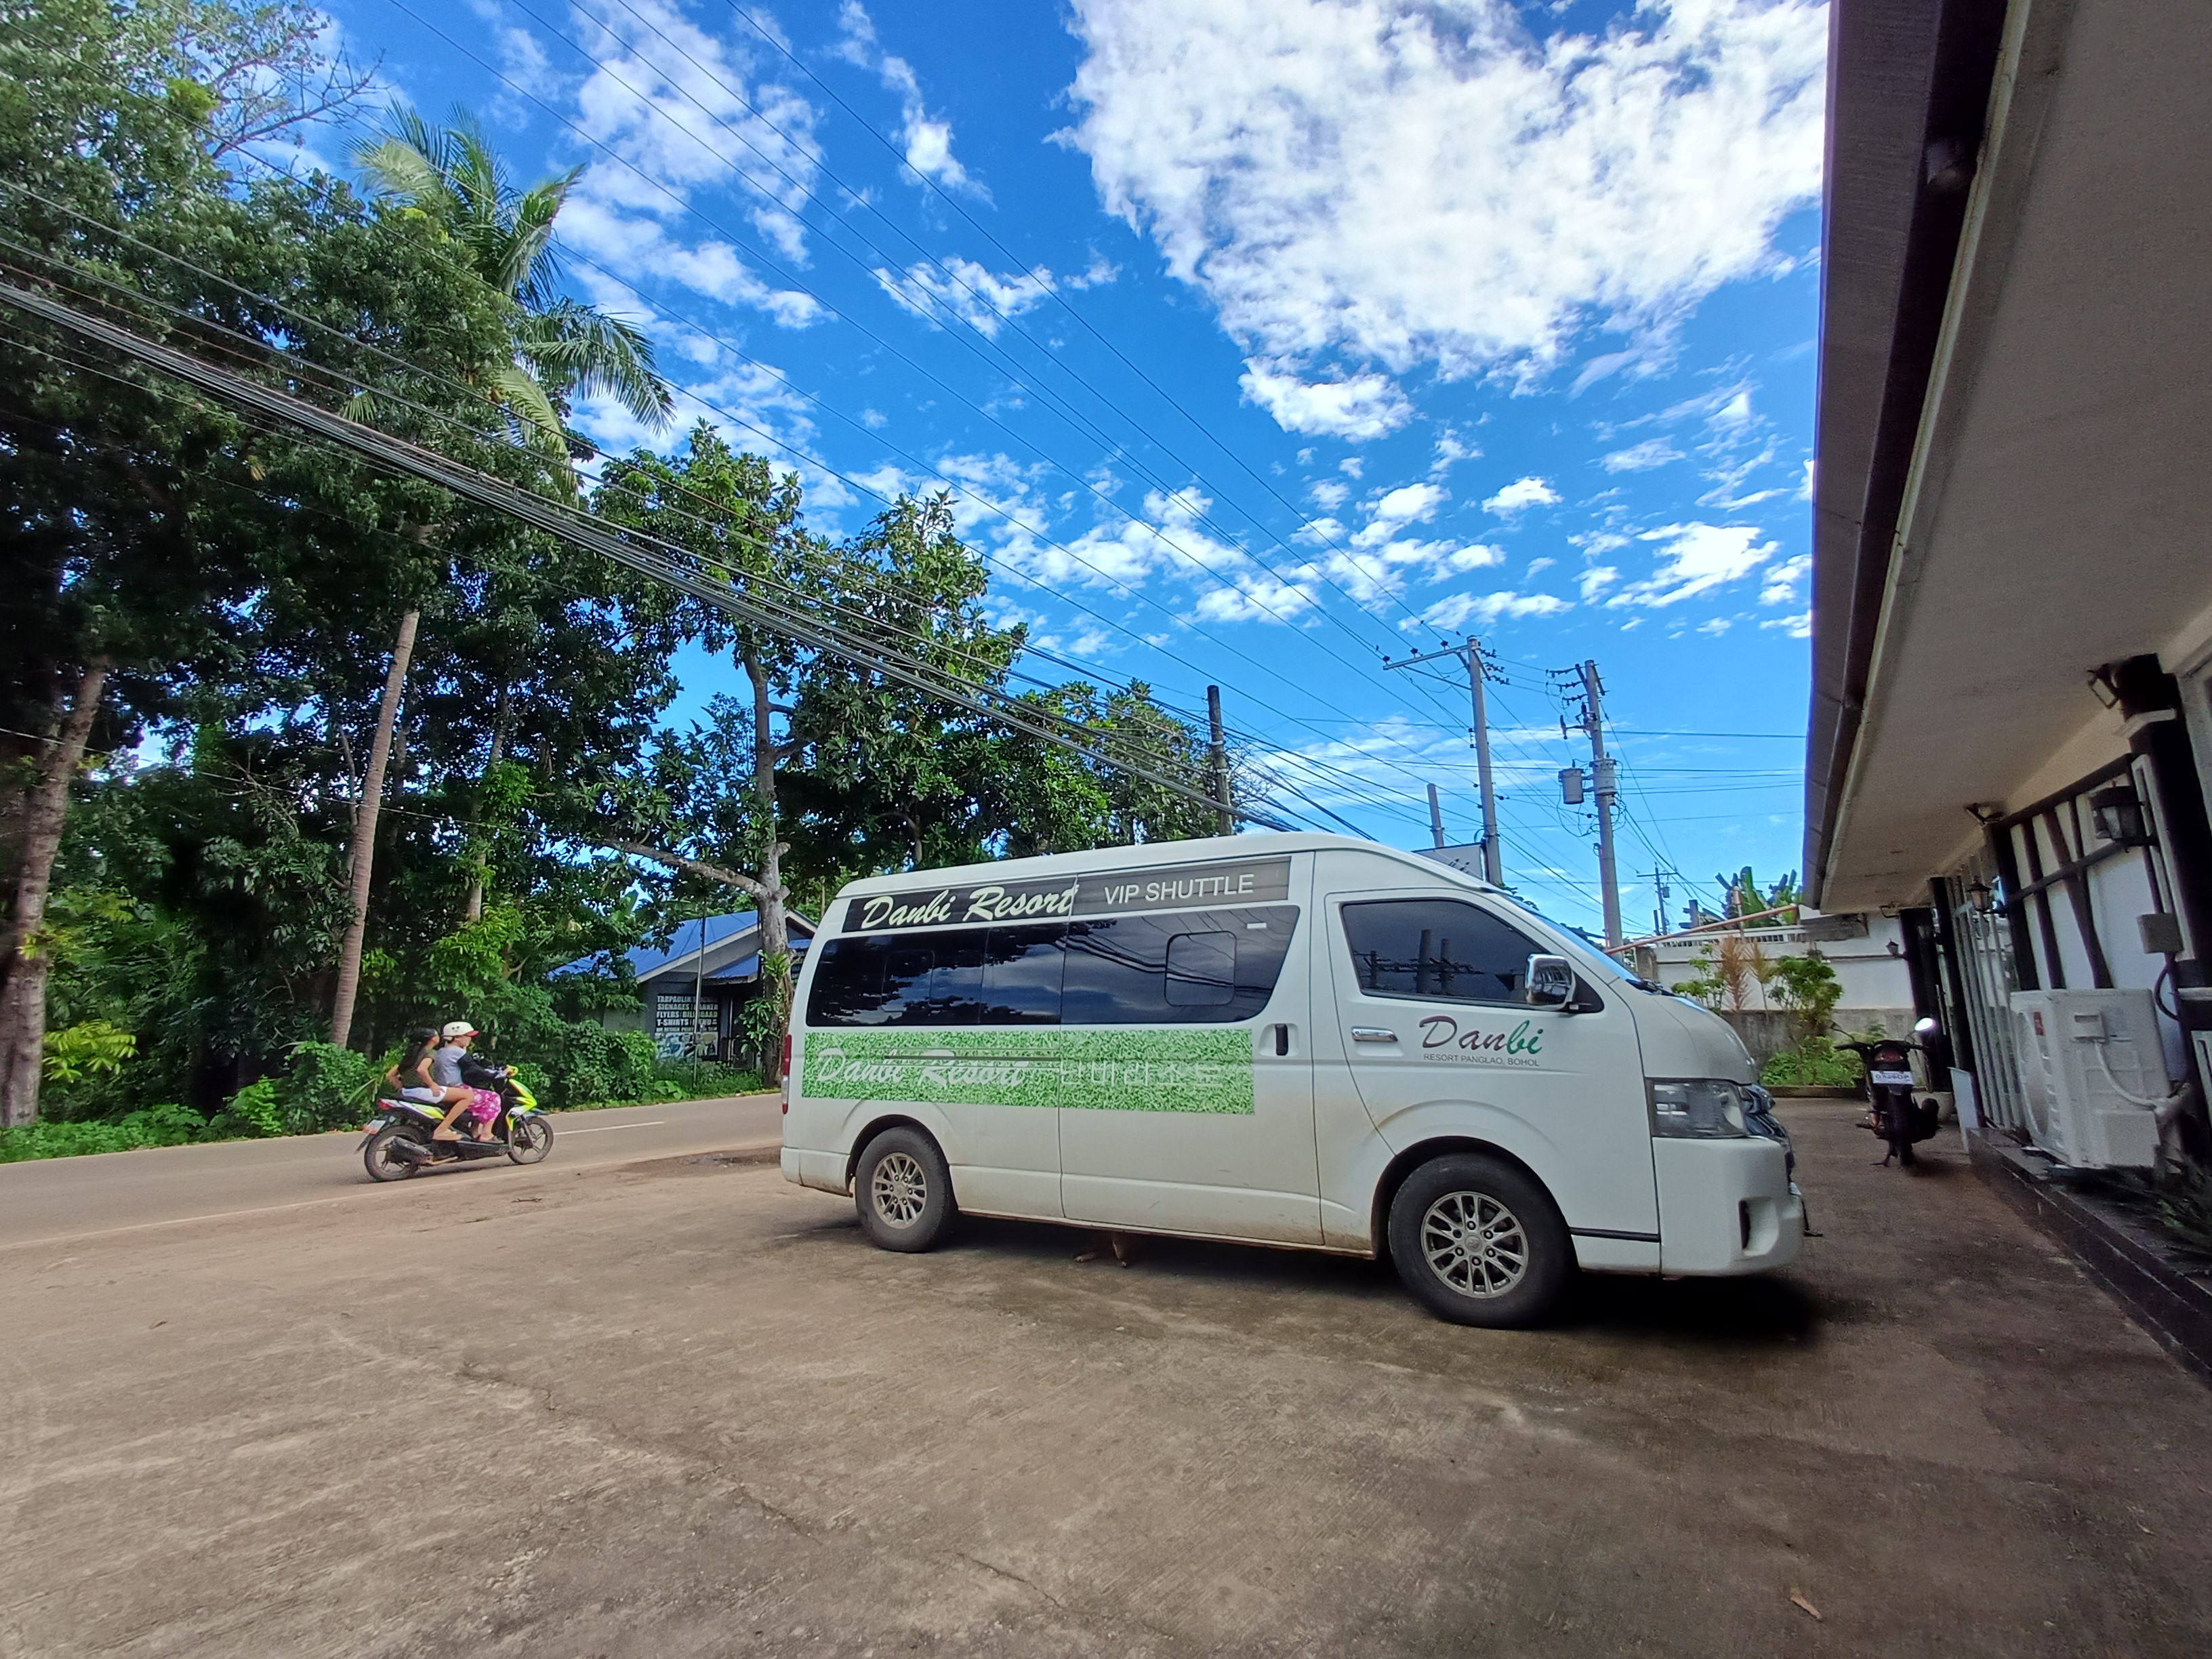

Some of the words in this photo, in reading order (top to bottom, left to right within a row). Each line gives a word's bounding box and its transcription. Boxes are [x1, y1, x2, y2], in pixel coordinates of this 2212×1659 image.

[861, 889, 956, 930] Danbi
[962, 884, 1080, 922] Resort
[1105, 884, 1140, 905] VIP
[1145, 873, 1254, 902] SHUTTLE
[1418, 1015, 1544, 1055] Danbi
[1423, 1053, 1458, 1062] RESORT
[1460, 1055, 1505, 1066] PANGLAO,
[1507, 1057, 1540, 1067] BOHOL
